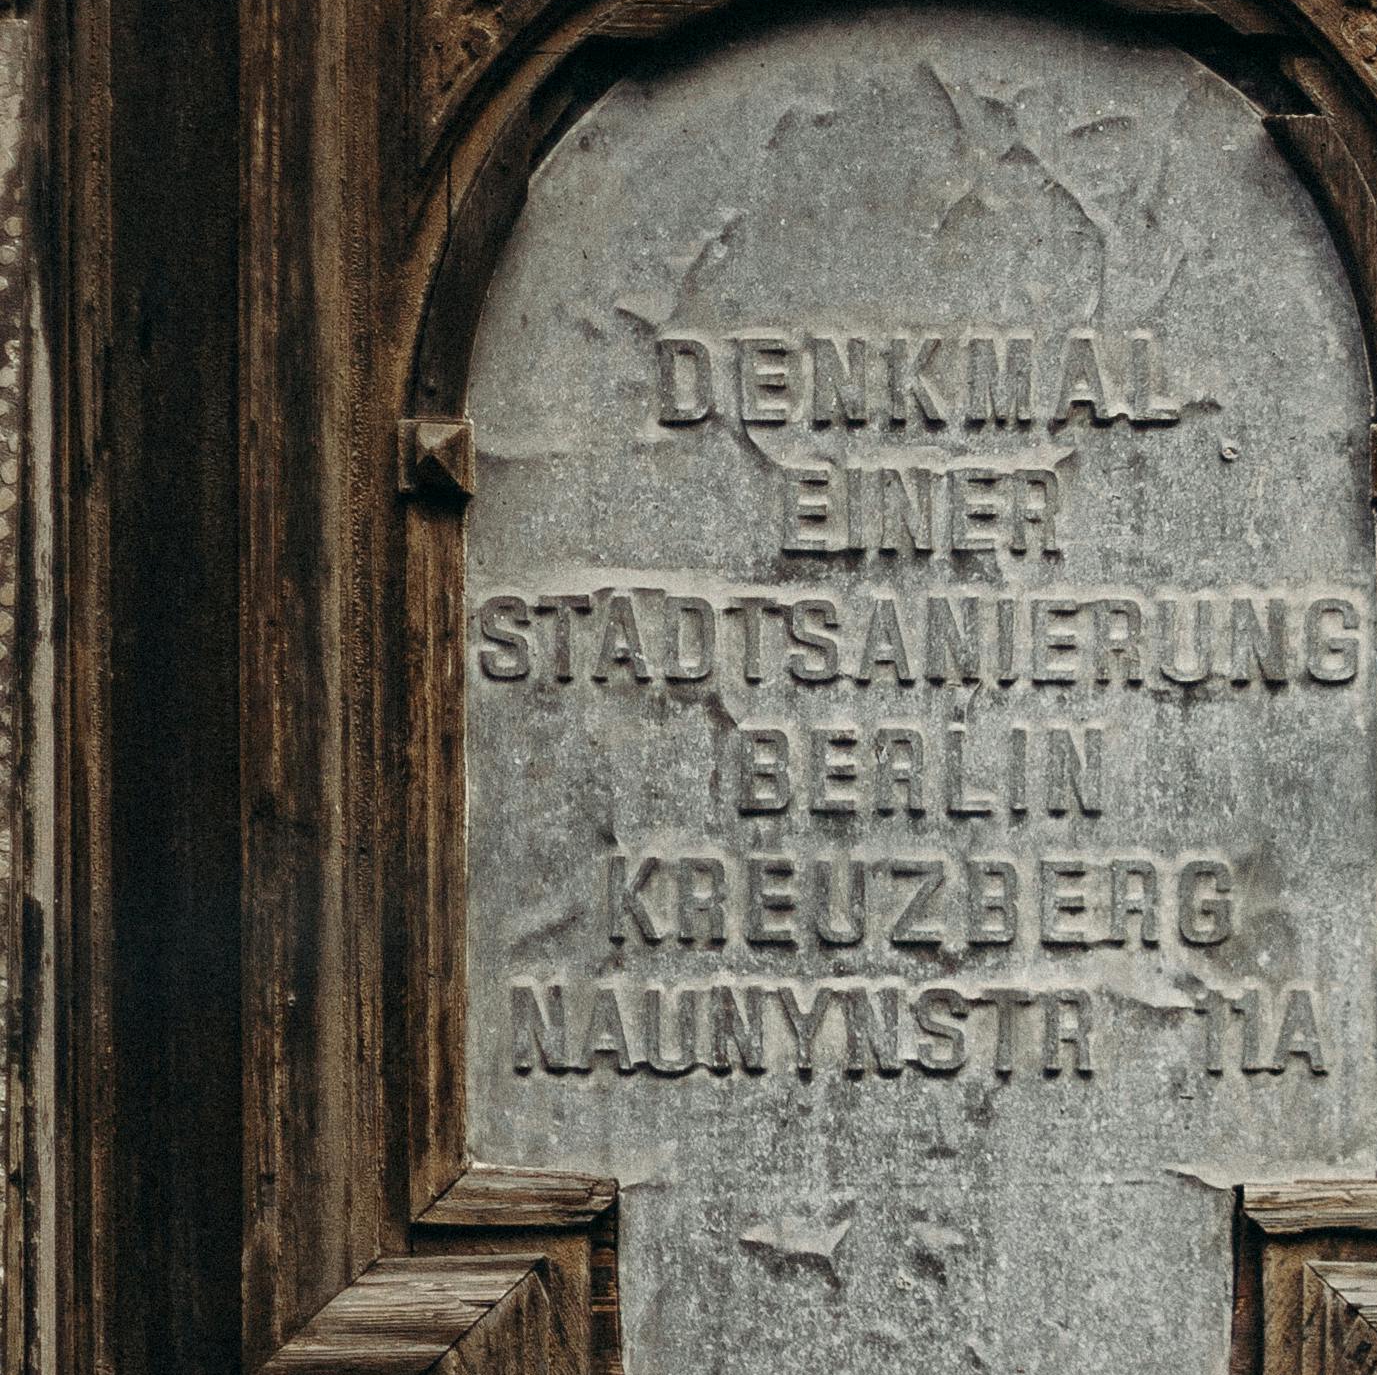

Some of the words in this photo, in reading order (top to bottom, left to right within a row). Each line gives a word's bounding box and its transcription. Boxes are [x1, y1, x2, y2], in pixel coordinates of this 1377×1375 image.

[655, 332, 1182, 427] DENKMAL
[781, 464, 1062, 556] EINER
[477, 588, 1361, 687] STADTSANIERUNG
[736, 724, 1104, 819] BERLIN
[604, 855, 1237, 949] KREUZBERG
[509, 982, 1095, 1079] NAUNYNSTR
[1193, 986, 1331, 1077] 11A
